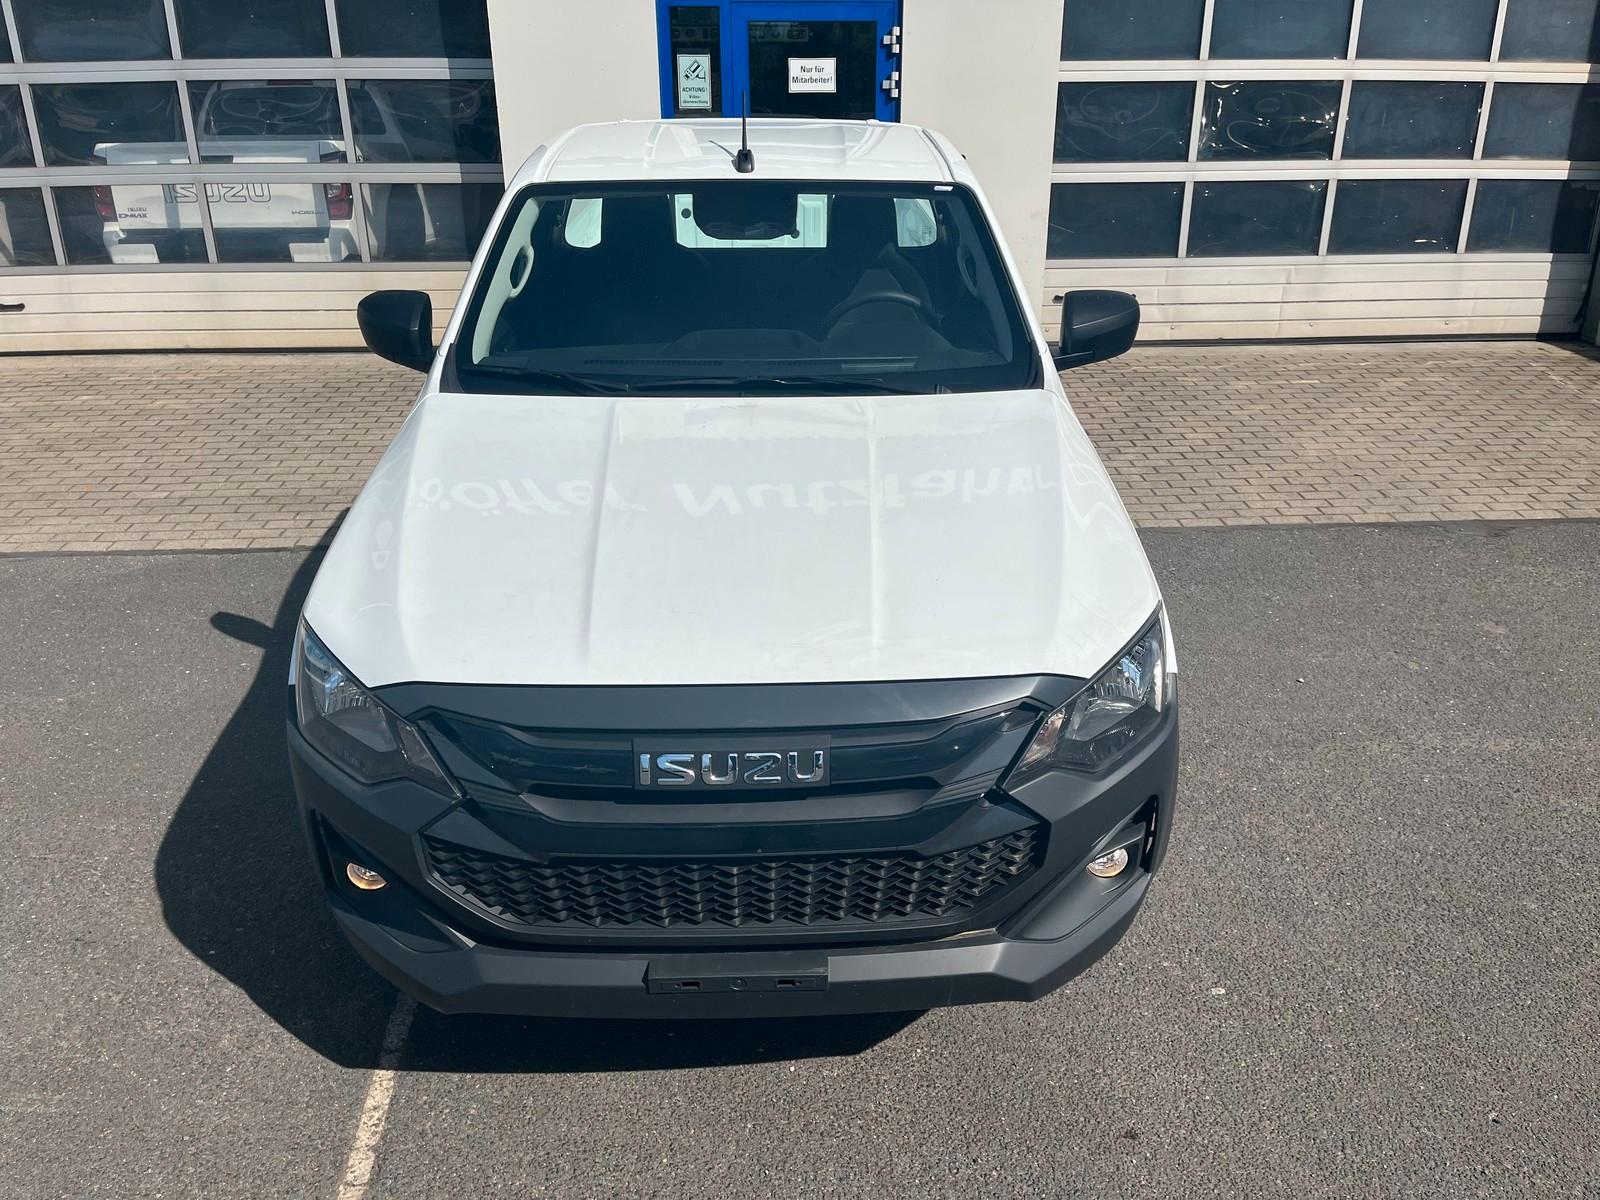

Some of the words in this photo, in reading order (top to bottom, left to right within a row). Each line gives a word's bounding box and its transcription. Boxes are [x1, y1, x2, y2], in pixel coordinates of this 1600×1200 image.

[800, 65, 813, 73] Nur
[814, 65, 825, 73] für
[792, 75, 833, 84] Mitarbeiter!
[640, 750, 824, 785] ISUZU
